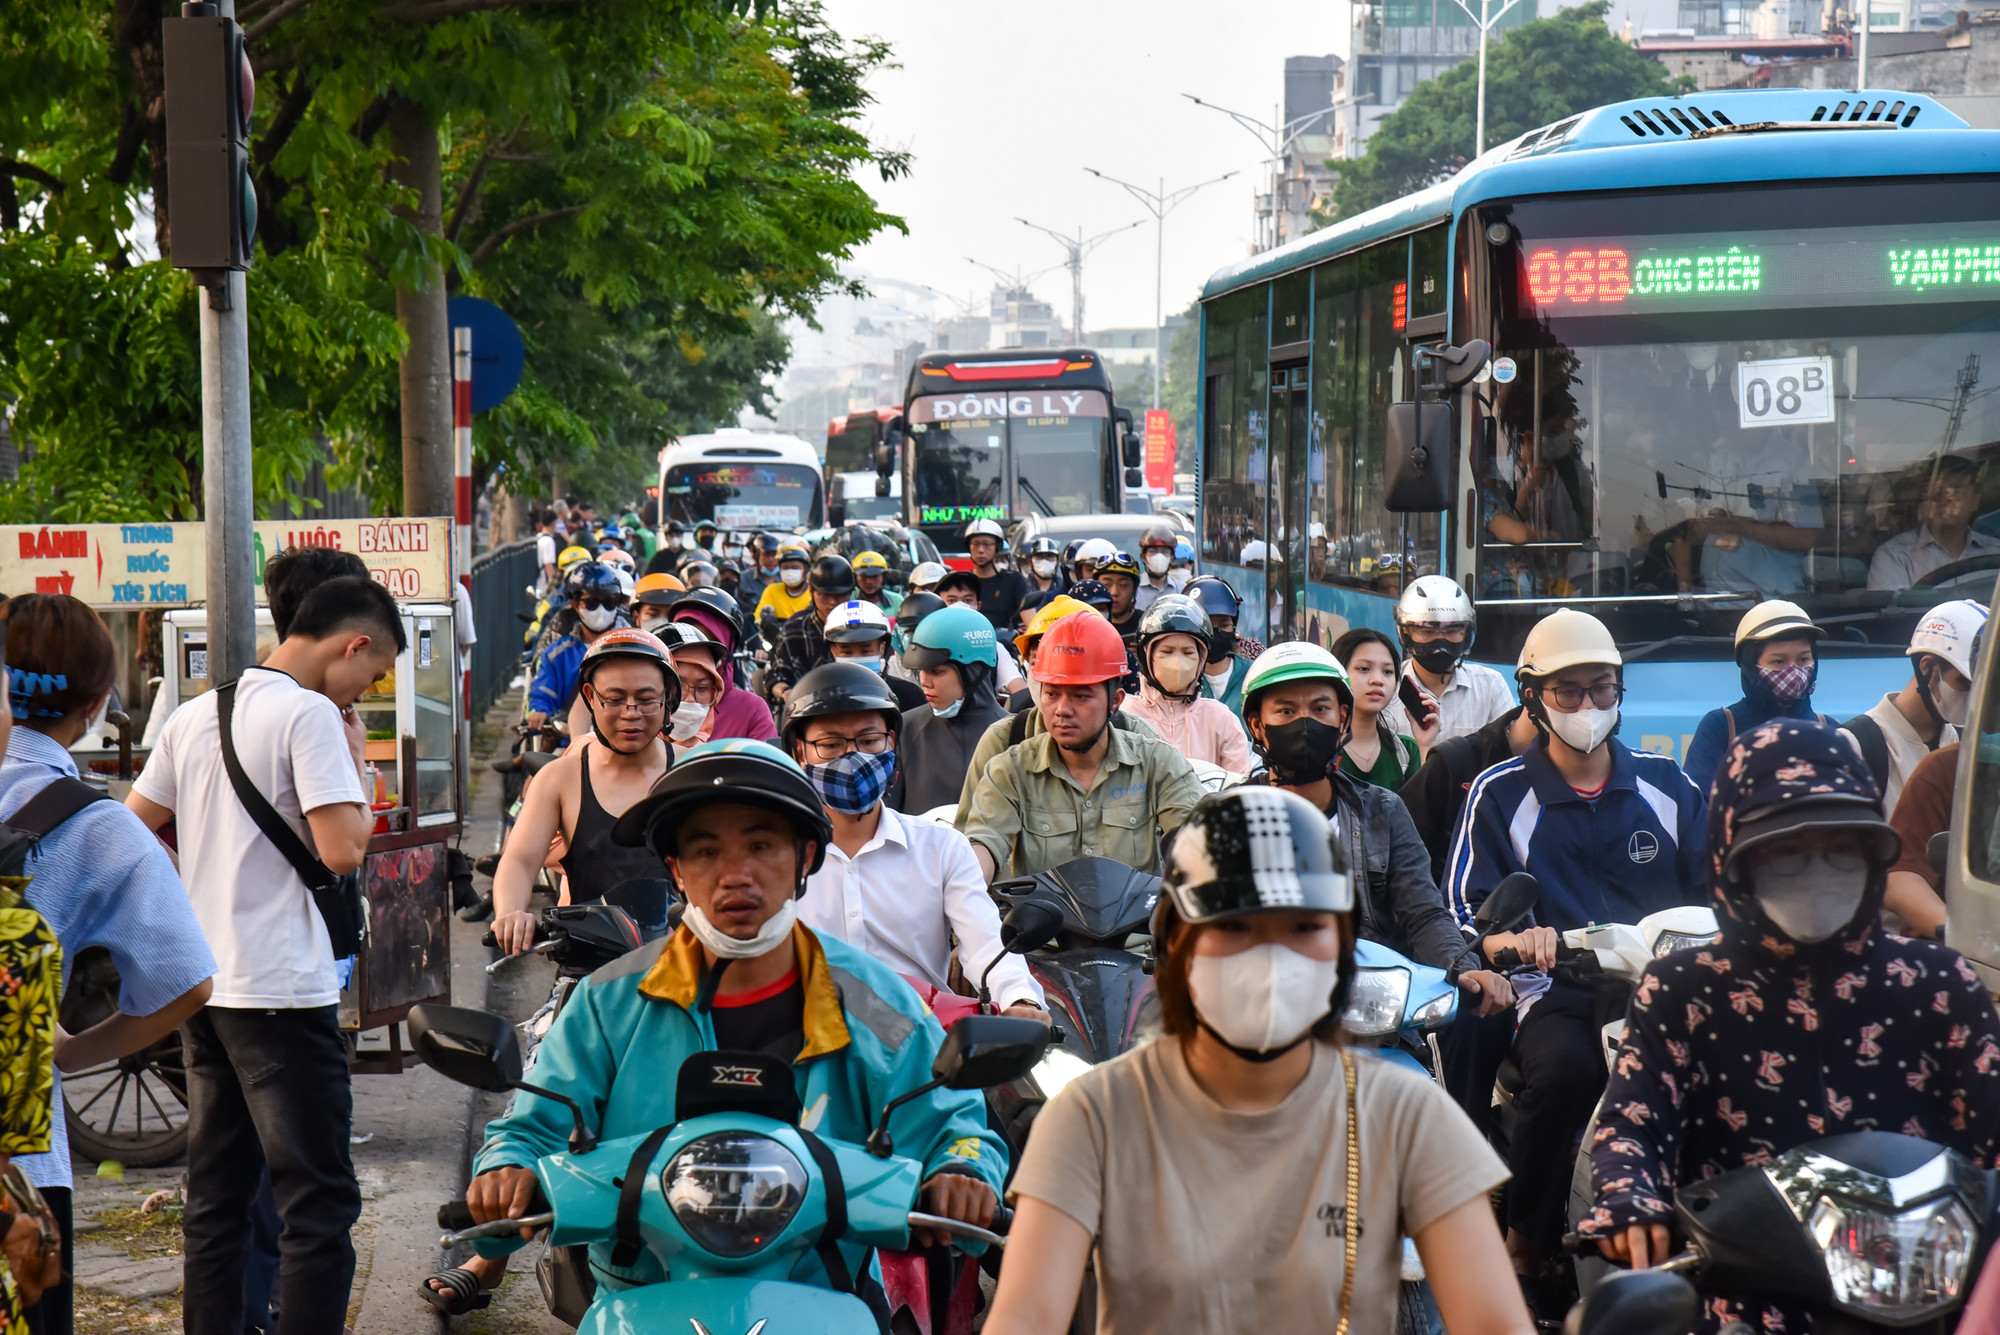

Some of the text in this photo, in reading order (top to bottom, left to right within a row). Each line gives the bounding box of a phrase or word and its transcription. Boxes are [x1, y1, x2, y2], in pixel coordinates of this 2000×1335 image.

[1529, 246, 1760, 304] 08B ONG BIÊN
[1889, 248, 1949, 291] VẠN
[932, 391, 1084, 419] ĐÔNG LÝ
[18, 527, 88, 559] BÁNH
[359, 520, 428, 552] BÁNH
[112, 581, 187, 602] XÚC XÍCH
[969, 630, 993, 640] URGO
[1926, 622, 1945, 631] JVC
